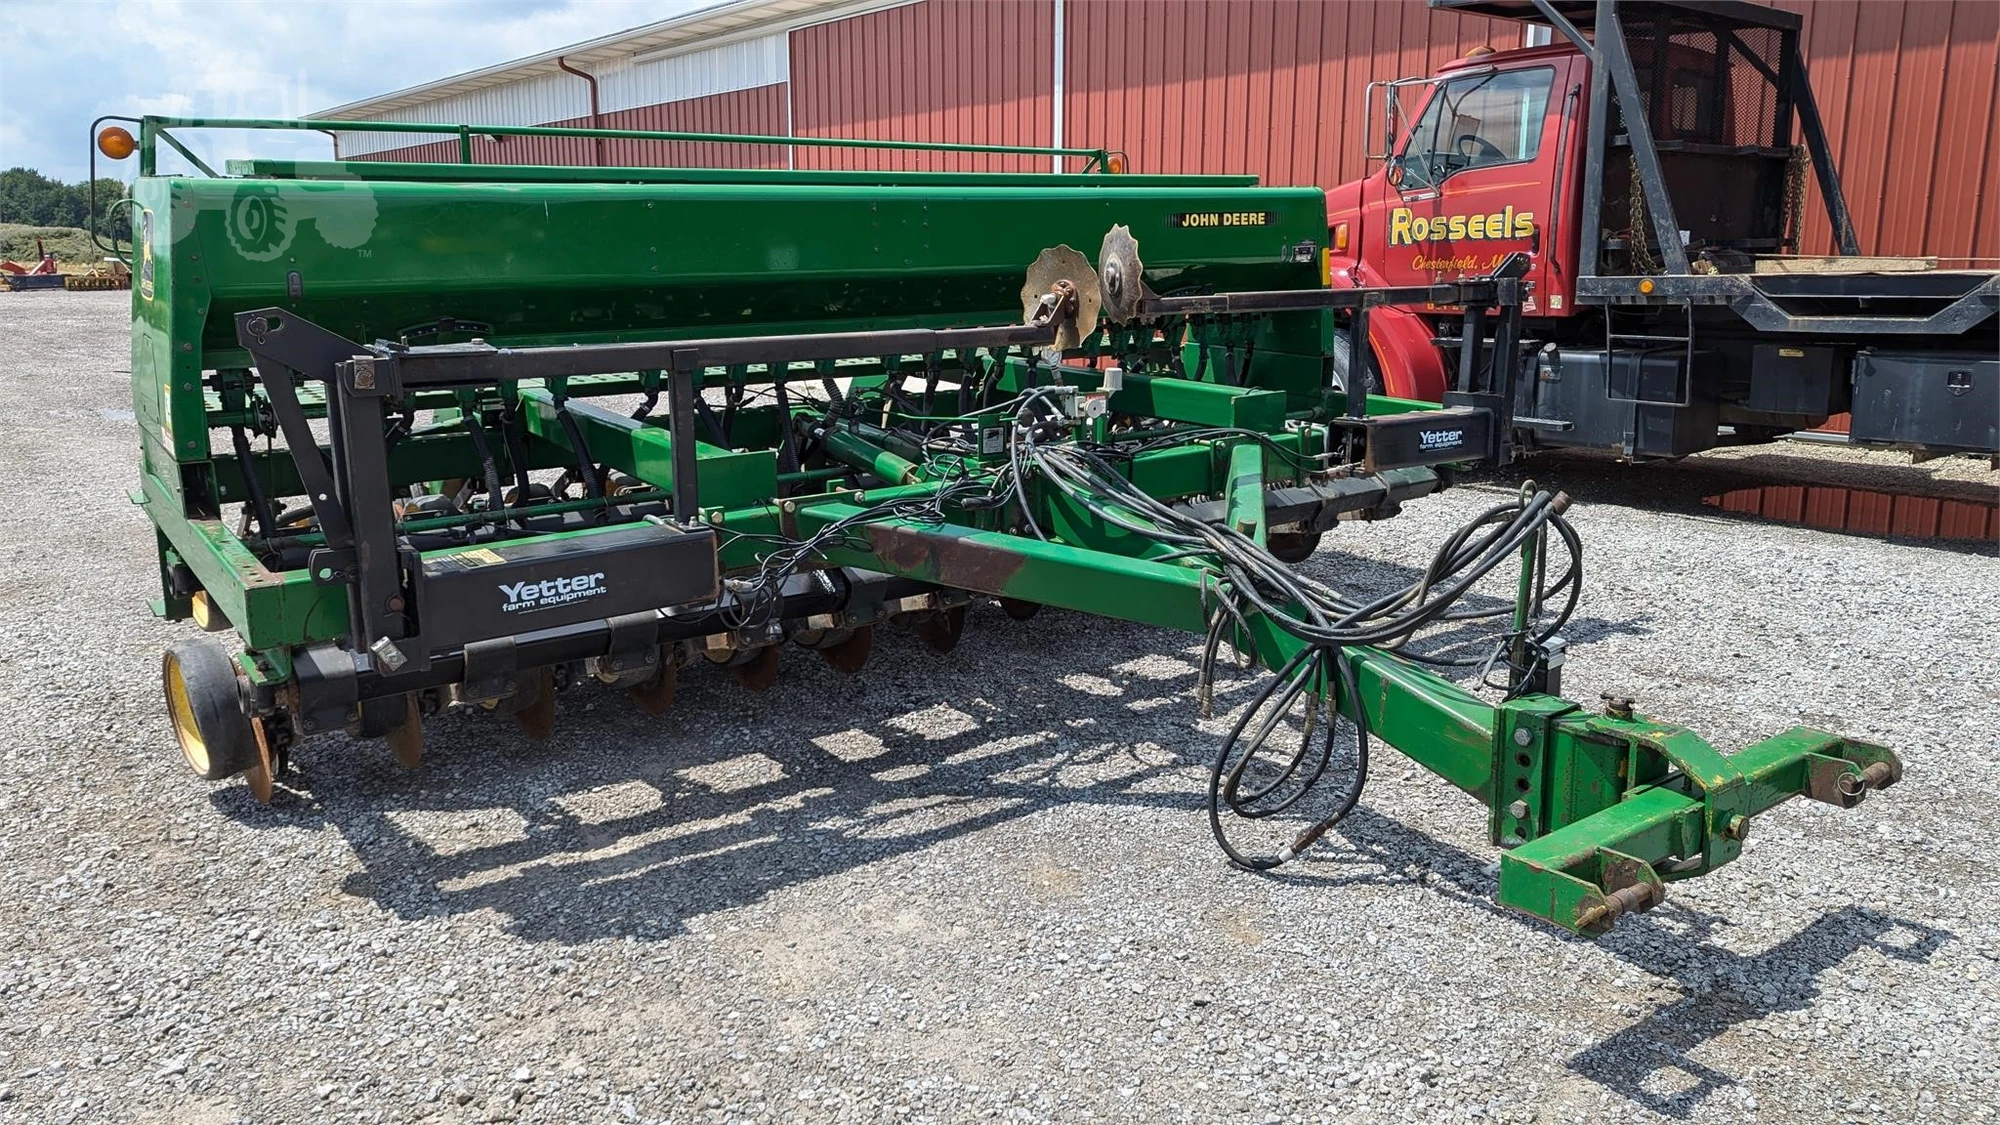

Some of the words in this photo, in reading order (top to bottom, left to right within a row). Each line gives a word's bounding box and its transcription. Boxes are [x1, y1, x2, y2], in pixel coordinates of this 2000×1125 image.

[1182, 213, 1219, 227] JOHN
[1223, 212, 1266, 226] DEERE
[1391, 205, 1535, 245] Rosseels
[1482, 253, 1504, 270] M
[1420, 430, 1463, 444] Yetter
[1434, 439, 1463, 448] equipment
[498, 572, 605, 603] Yetter
[502, 600, 535, 612] farm
[540, 586, 607, 605] equipment
